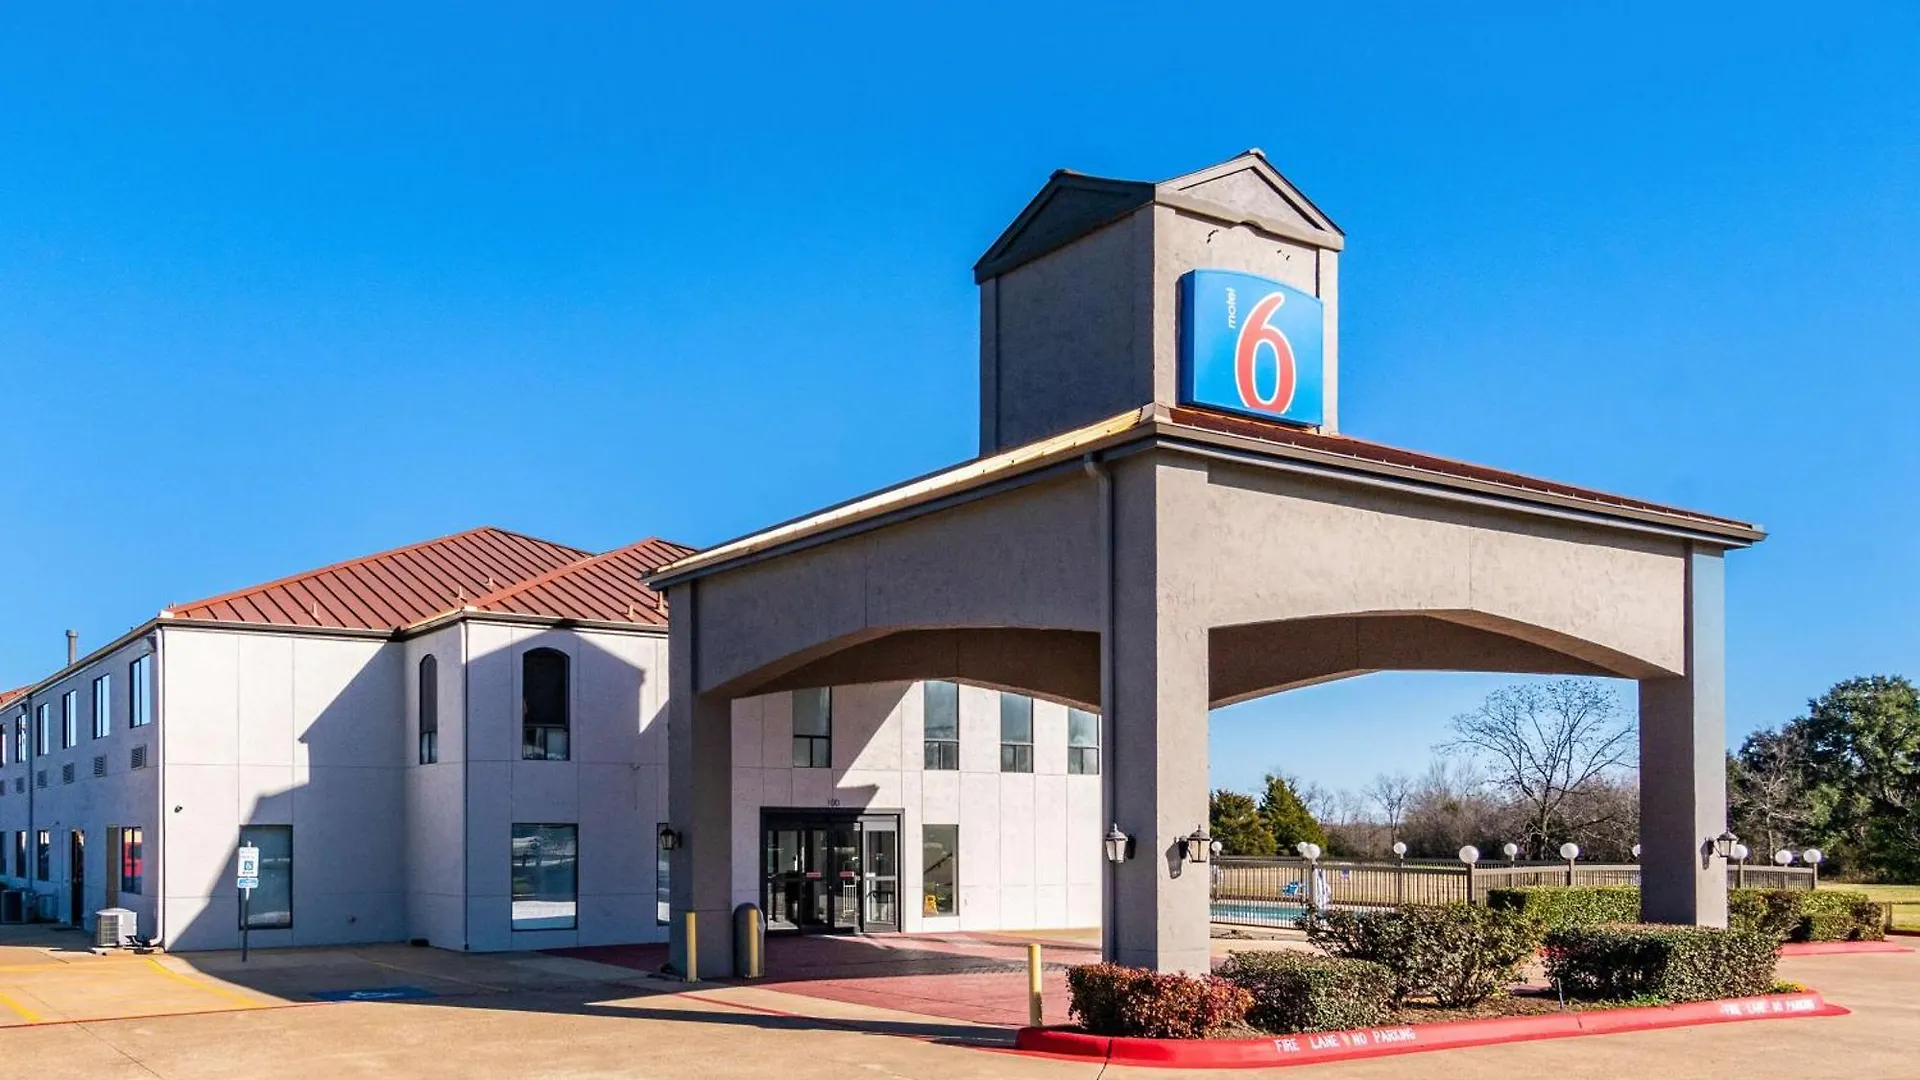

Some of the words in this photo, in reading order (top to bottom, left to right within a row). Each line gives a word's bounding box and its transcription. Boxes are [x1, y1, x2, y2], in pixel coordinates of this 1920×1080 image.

[1226, 287, 1237, 329] motel
[1234, 291, 1297, 415] 6
[1274, 1039, 1300, 1052] FIRE
[1309, 1034, 1340, 1050] LANE
[1352, 1032, 1368, 1046] NO
[1372, 1027, 1417, 1044] PARKING
